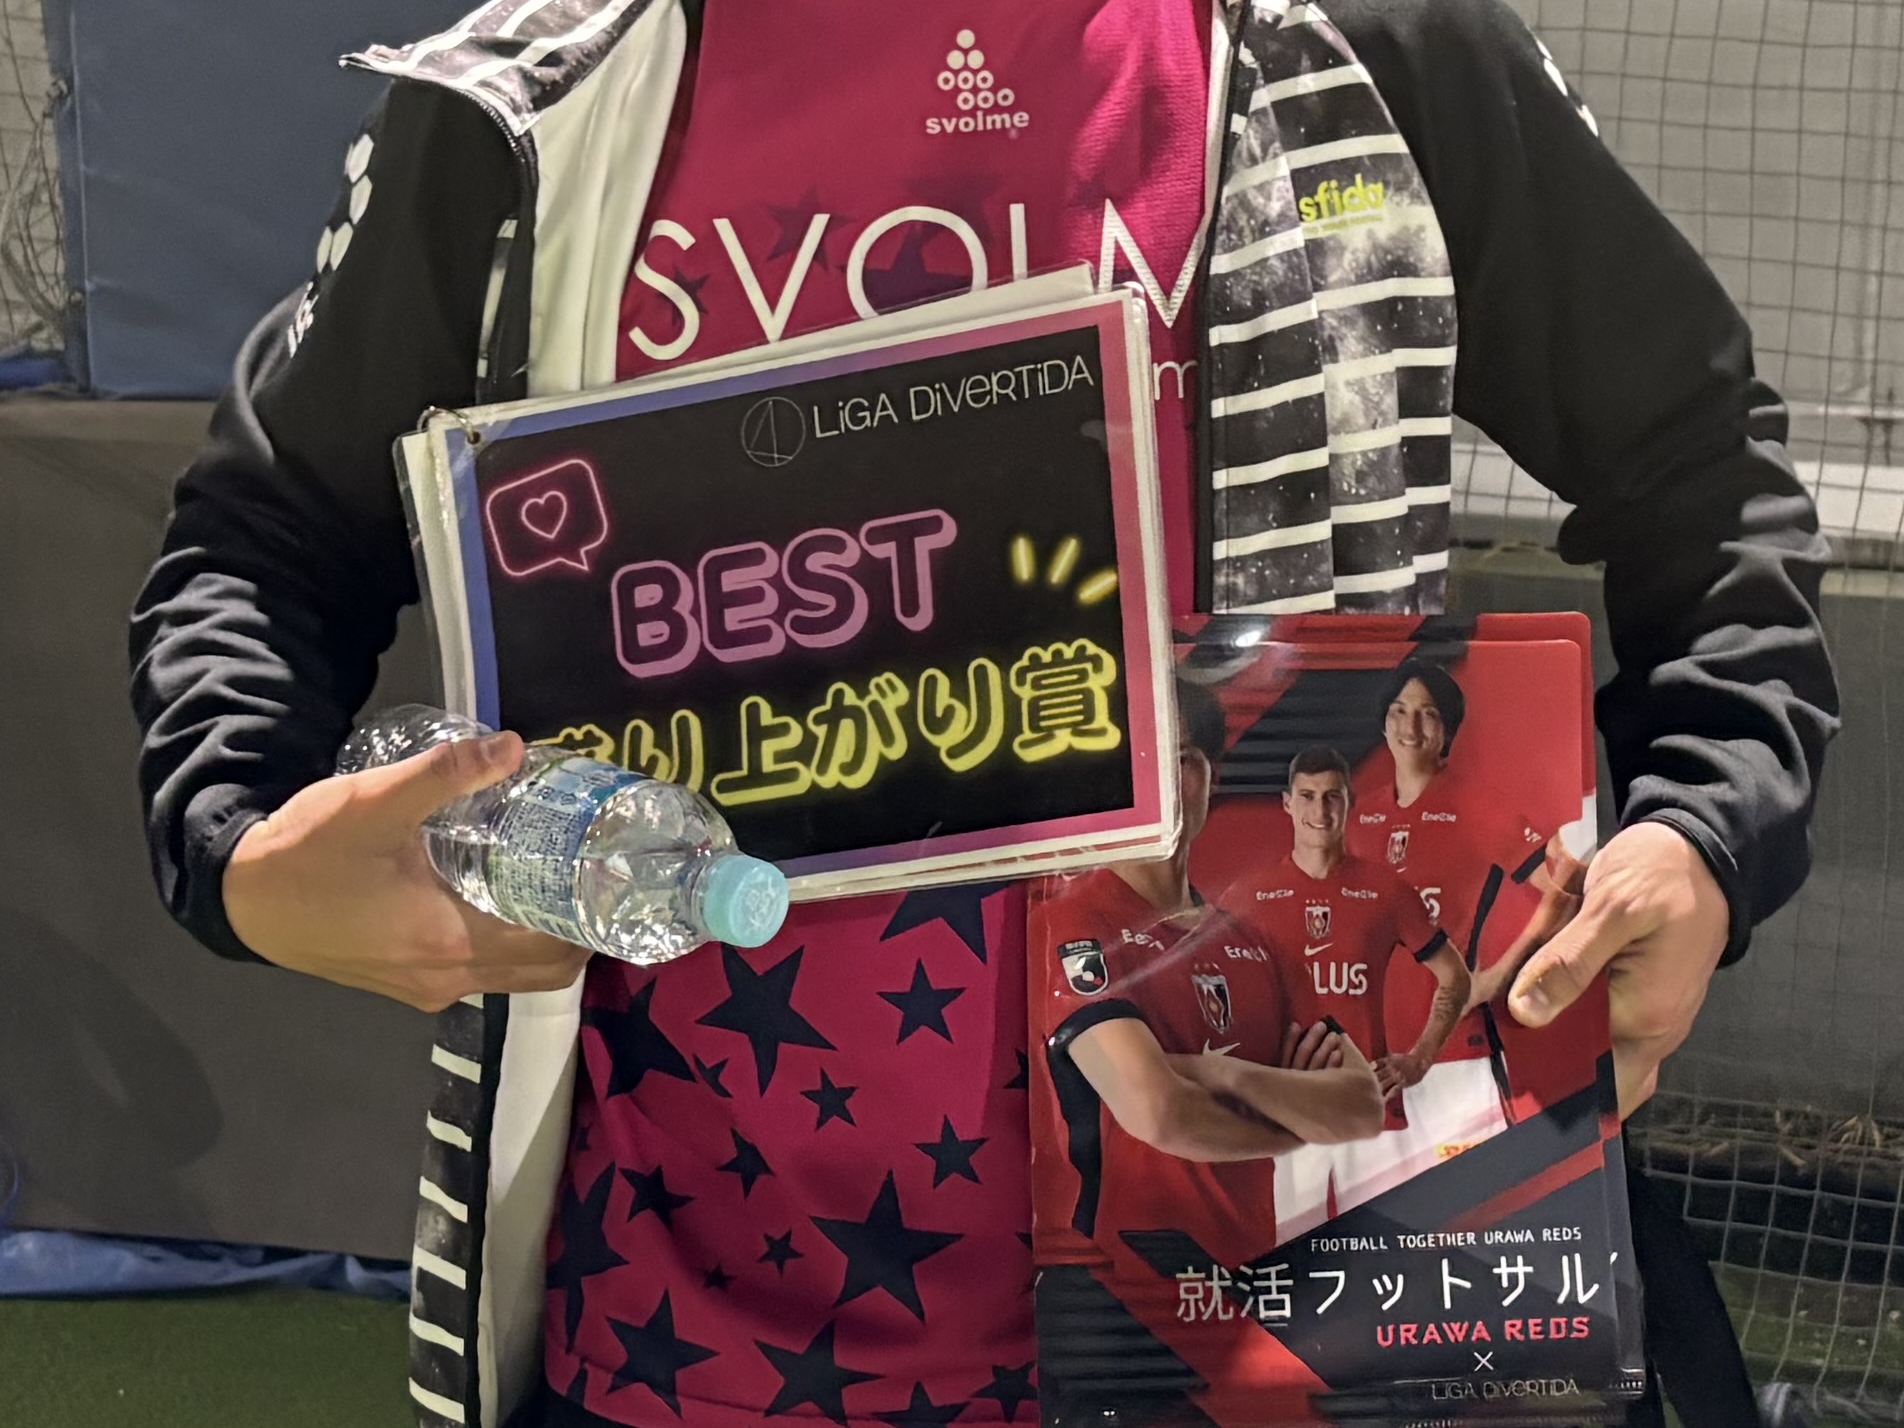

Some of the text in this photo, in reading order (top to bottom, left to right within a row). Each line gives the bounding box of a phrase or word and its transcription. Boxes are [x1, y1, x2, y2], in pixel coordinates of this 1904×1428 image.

[925, 110, 1030, 135] svolme
[1298, 172, 1385, 222] sfida
[610, 507, 959, 679] BEST
[528, 637, 1123, 806] り上がり賞
[1306, 961, 1369, 996] LUS
[1310, 1226, 1583, 1253] FOOTBALL TOGETHER URAWA REDS
[1174, 1252, 1600, 1323] 就活フットサル
[1376, 1316, 1591, 1348] URAWA REDS
